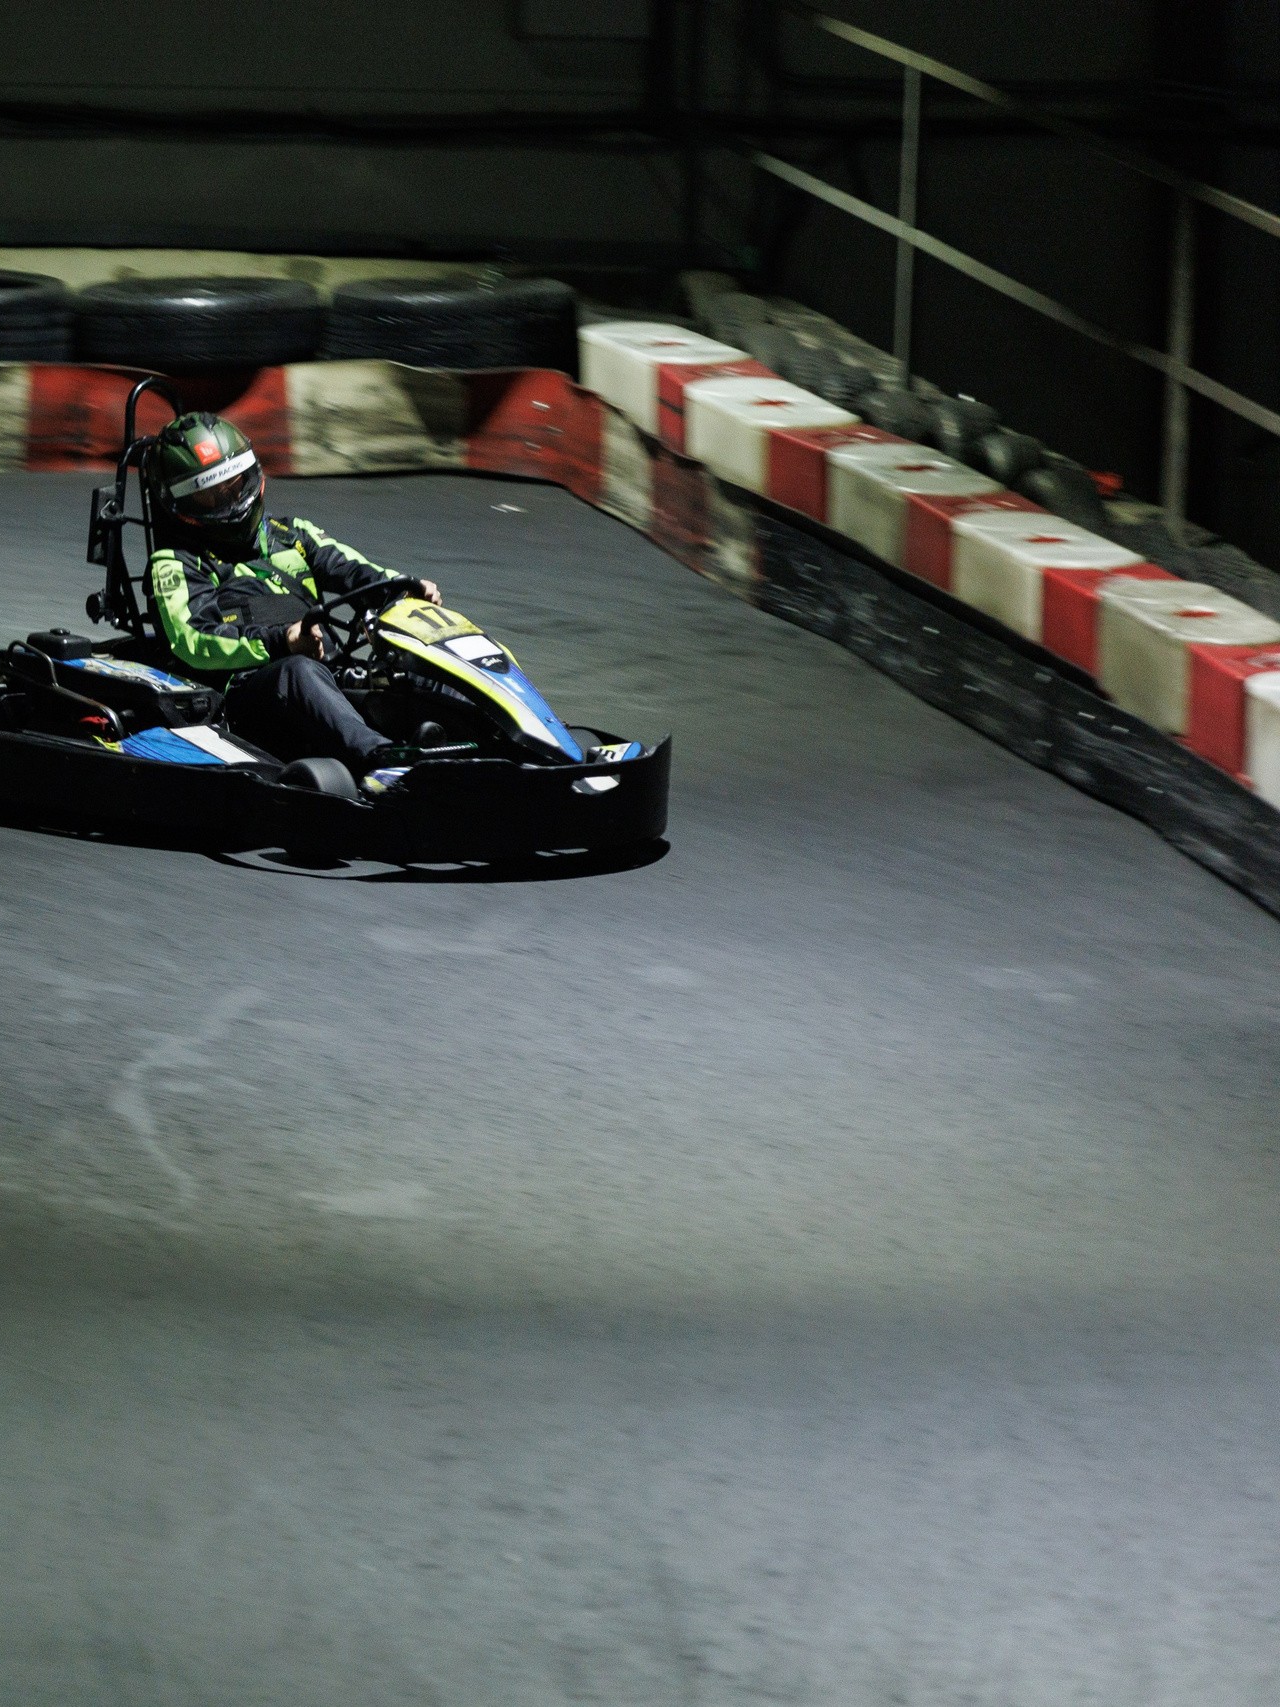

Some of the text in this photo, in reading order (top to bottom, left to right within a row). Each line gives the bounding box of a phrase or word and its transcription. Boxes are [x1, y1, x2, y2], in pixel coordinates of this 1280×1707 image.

[201, 462, 243, 485] SMP RACING
[407, 606, 457, 629] 17
